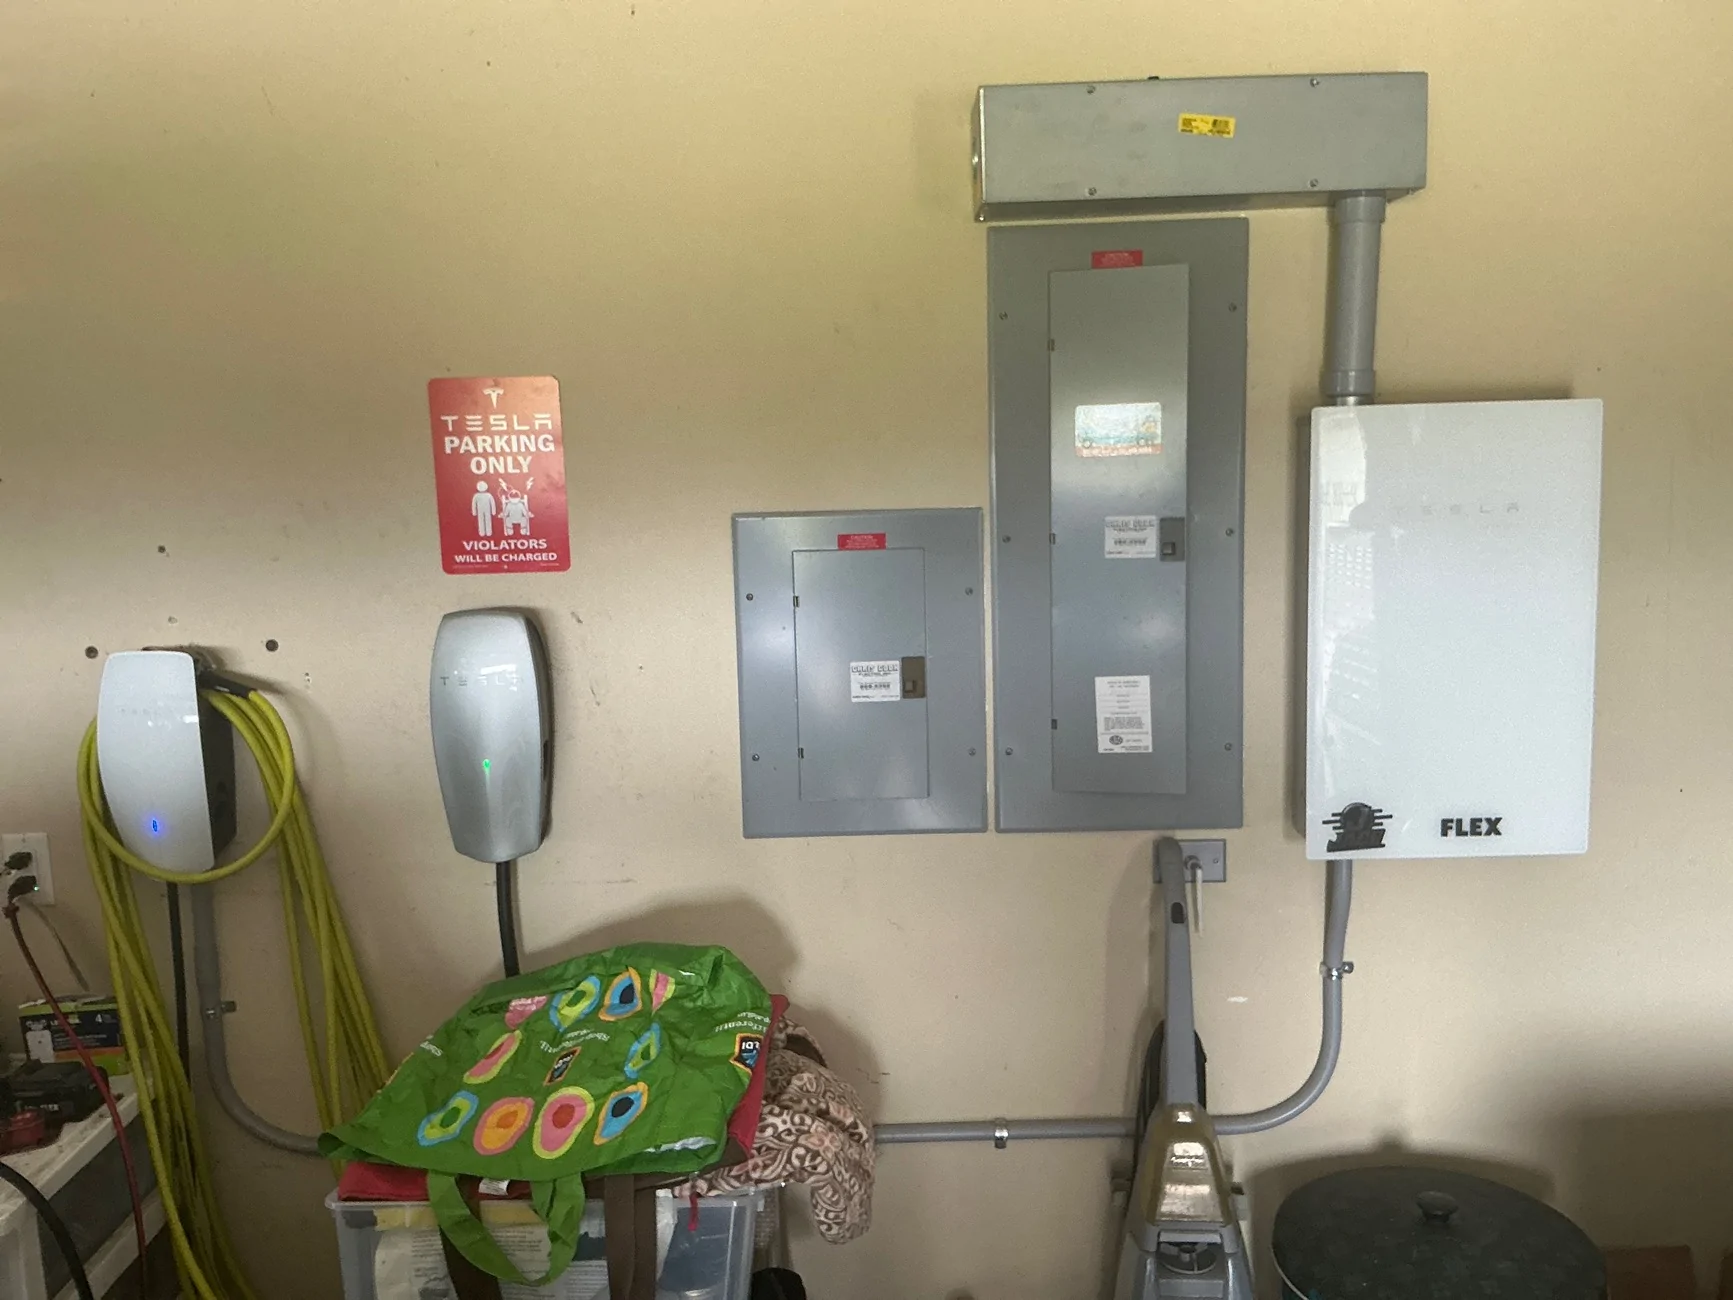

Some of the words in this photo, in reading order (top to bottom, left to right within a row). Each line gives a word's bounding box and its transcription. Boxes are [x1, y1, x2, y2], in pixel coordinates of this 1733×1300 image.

[441, 413, 552, 432] TESLA
[444, 435, 555, 454] PARKING
[470, 456, 533, 475] ONLY
[463, 538, 548, 551] VIOLATORS
[455, 554, 483, 563] WILL
[486, 553, 499, 563] BE
[502, 553, 557, 562] CHARGED
[1440, 817, 1502, 837] FLEX
[741, 1040, 760, 1050] LDI
